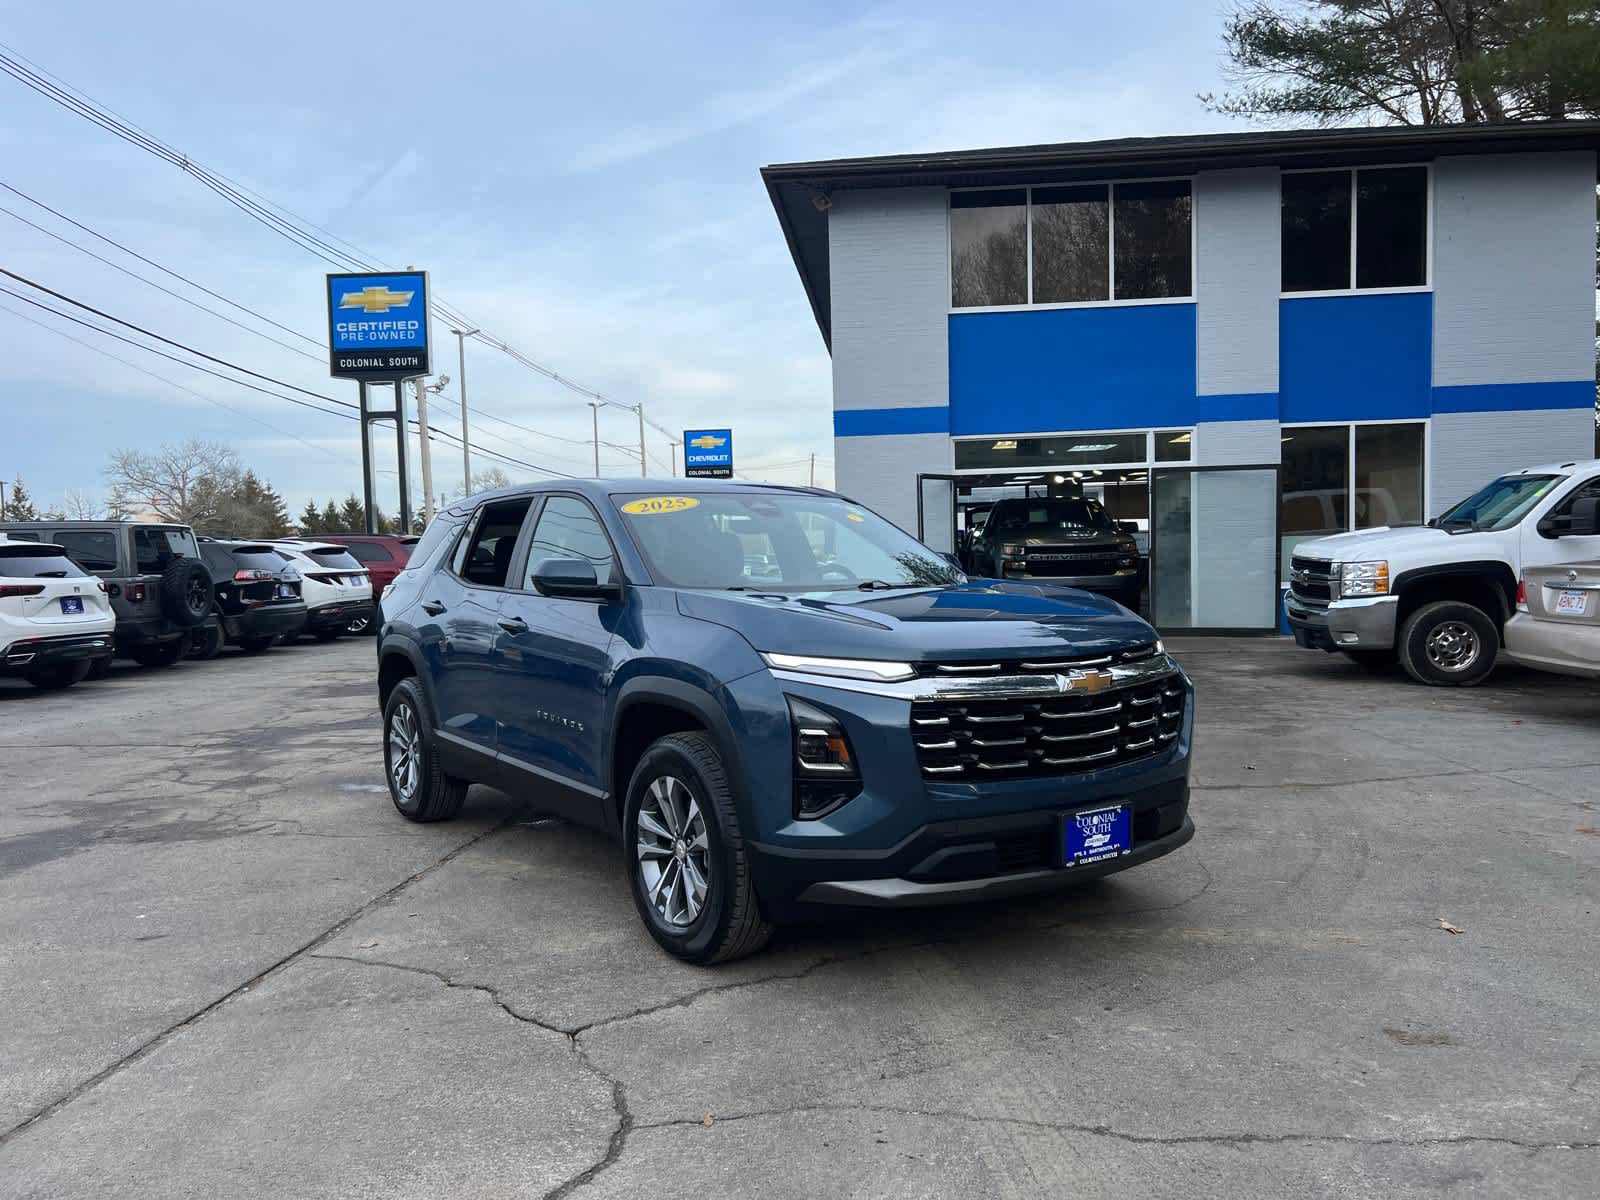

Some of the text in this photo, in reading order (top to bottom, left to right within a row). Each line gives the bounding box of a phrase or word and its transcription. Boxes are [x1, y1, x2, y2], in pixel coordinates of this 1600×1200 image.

[336, 320, 419, 331] CERTIFIED
[341, 331, 416, 341] PRE-OWNED
[340, 357, 418, 368] COLONIAL SOUTH
[640, 499, 686, 512] 2025
[1076, 813, 1117, 828] COLONIAL
[1083, 823, 1111, 837] SOUTH
